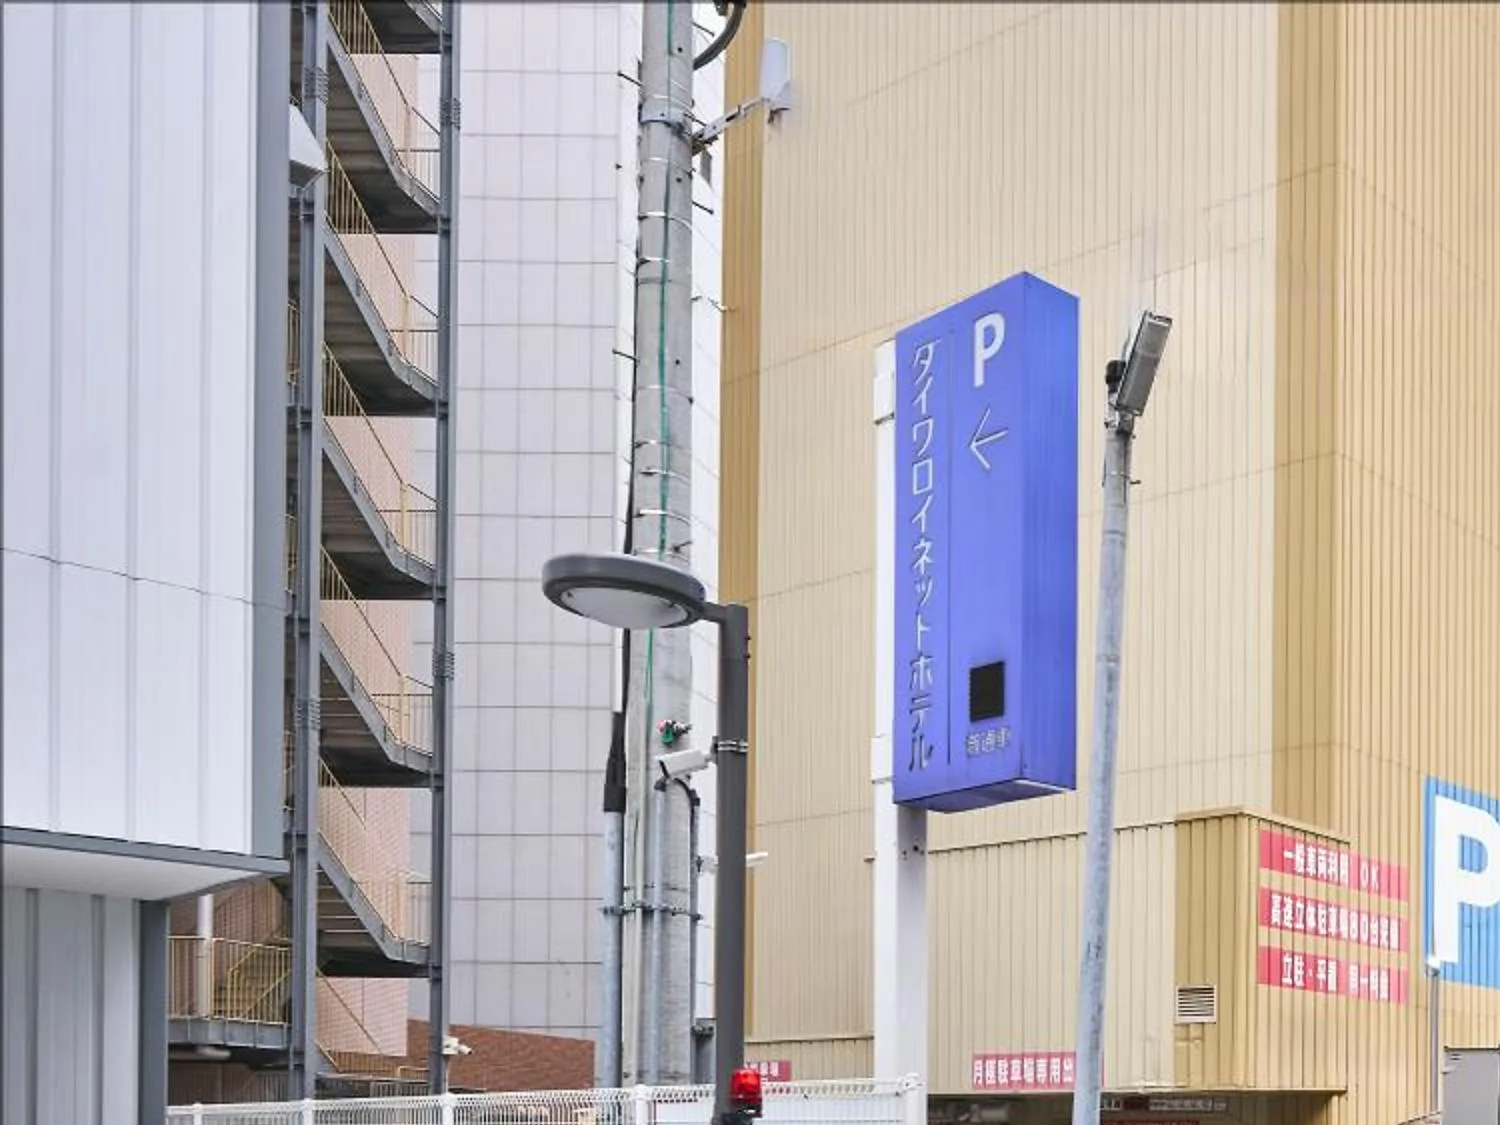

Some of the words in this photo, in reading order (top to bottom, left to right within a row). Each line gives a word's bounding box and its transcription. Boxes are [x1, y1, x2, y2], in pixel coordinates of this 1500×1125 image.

[974, 312, 1005, 388] P
[908, 338, 941, 772] ダイワロイネットホテル
